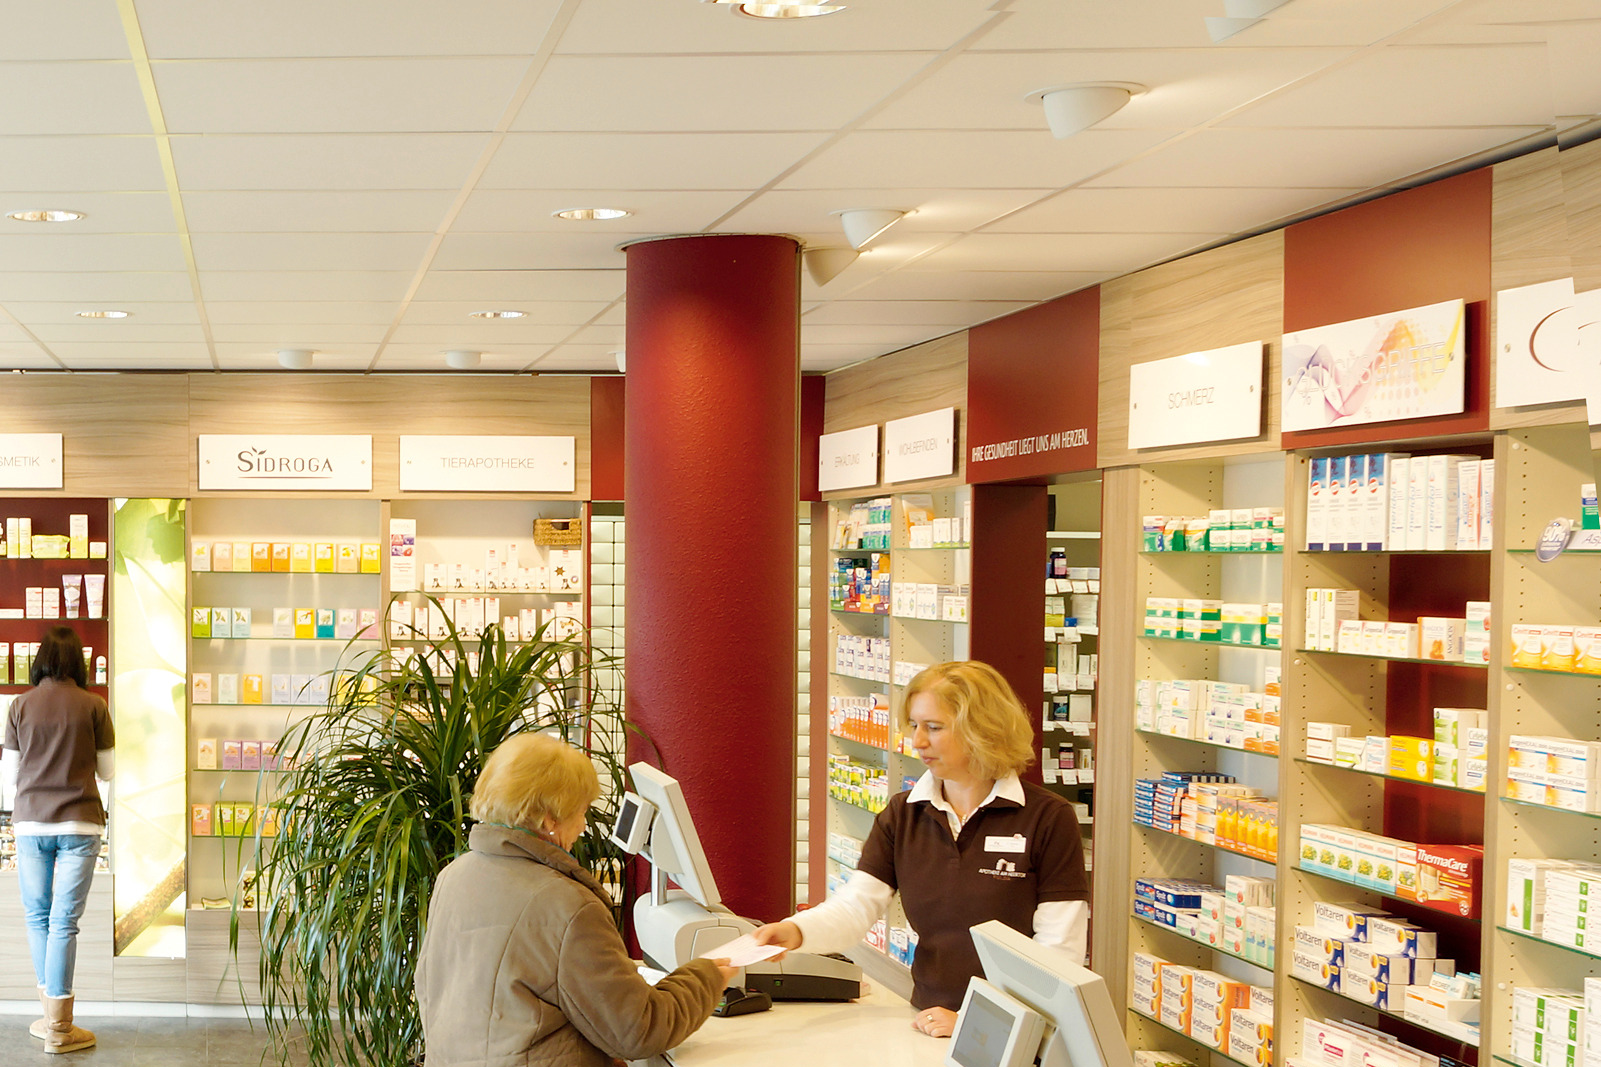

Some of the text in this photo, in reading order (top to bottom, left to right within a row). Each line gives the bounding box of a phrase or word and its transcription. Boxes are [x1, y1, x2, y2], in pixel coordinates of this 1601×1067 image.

[1168, 386, 1215, 409] SCHMERZ
[972, 428, 1090, 462] IHRE GESUNDHEIT LIEGT UNS AM HERZEN.
[439, 456, 535, 469] TIERAPOTHEKE
[1468, 730, 1488, 741] Celebe
[1466, 760, 1487, 770] Celebe
[1417, 848, 1469, 871] ThermaCare
[1315, 904, 1344, 923] Voltaren
[1373, 922, 1396, 935] Voltaren
[1295, 930, 1322, 947] Voltaren
[1350, 946, 1369, 960] Voltaren
[1294, 953, 1320, 971] Voltaren
[1162, 968, 1180, 981] Voltaren
[1193, 972, 1215, 989] Voltaren
[1349, 973, 1368, 986] Voltaren
[1163, 987, 1179, 999] Voltaren
[1250, 987, 1273, 1006] Voltare
[1161, 1005, 1178, 1018] Voltaren
[1193, 995, 1214, 1011] Voltaren
[1193, 1016, 1213, 1033] Voltaren
[1232, 1012, 1255, 1029] Voltaren
[1231, 1035, 1254, 1052] Voltaren
